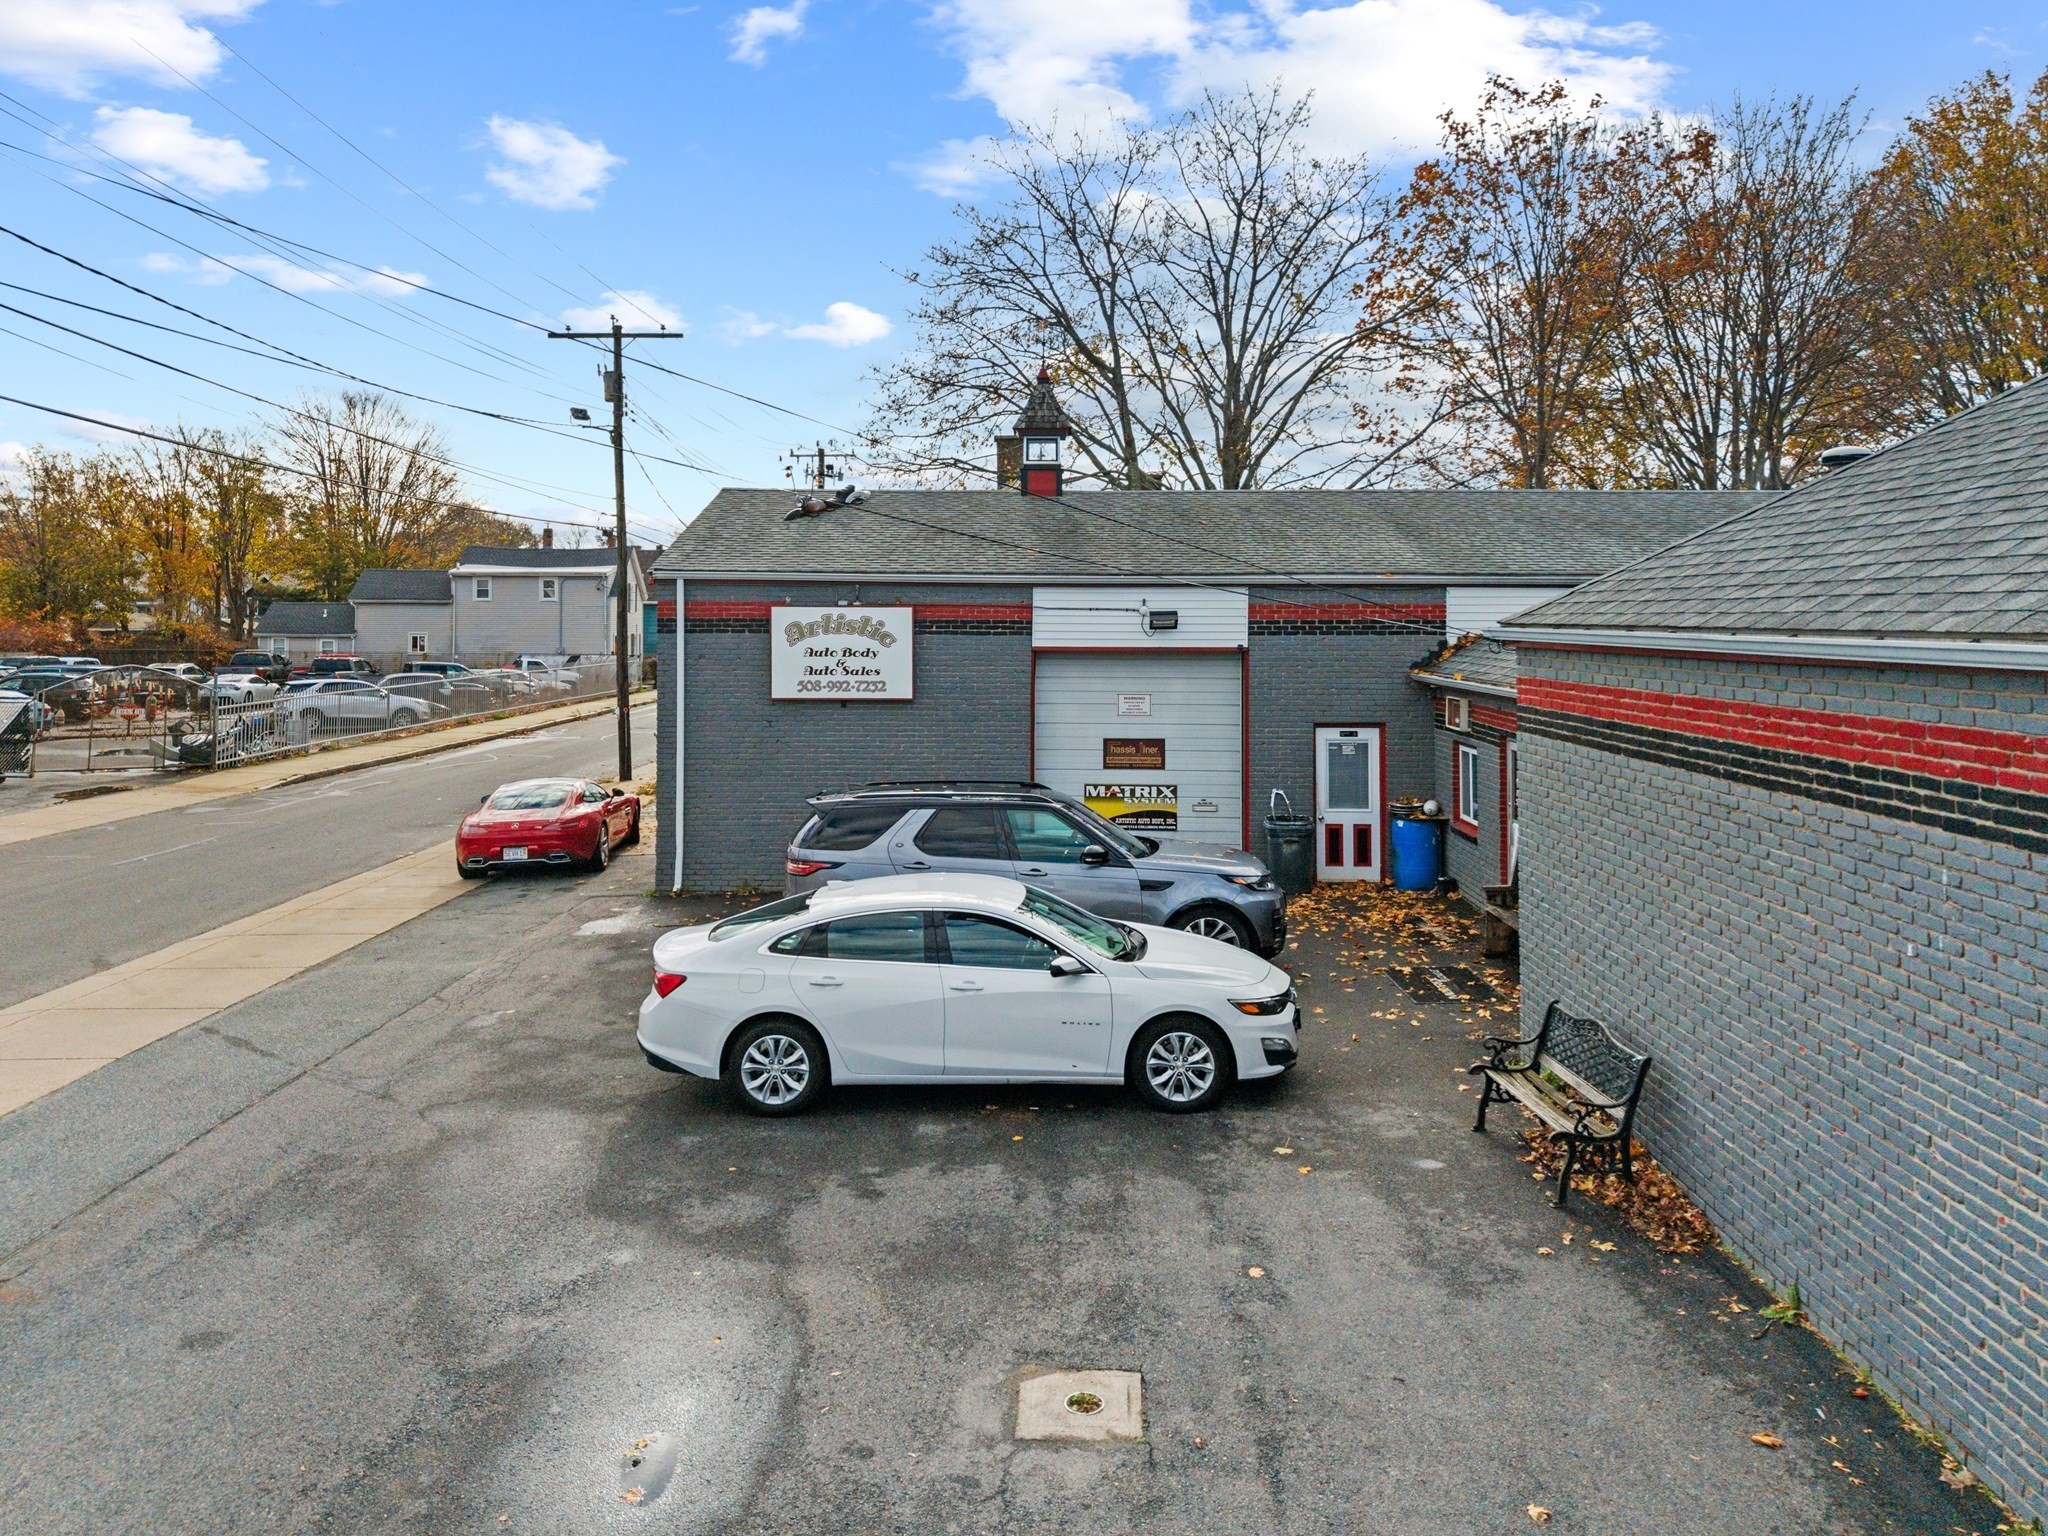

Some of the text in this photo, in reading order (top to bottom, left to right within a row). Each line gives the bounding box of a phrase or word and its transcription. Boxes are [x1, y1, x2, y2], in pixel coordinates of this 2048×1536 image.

[784, 613, 897, 648] Artistic
[803, 647, 880, 660] Auto Body
[836, 659, 847, 668] &
[803, 666, 881, 676] Auto Sales
[1085, 786, 1176, 798] MATRIX
